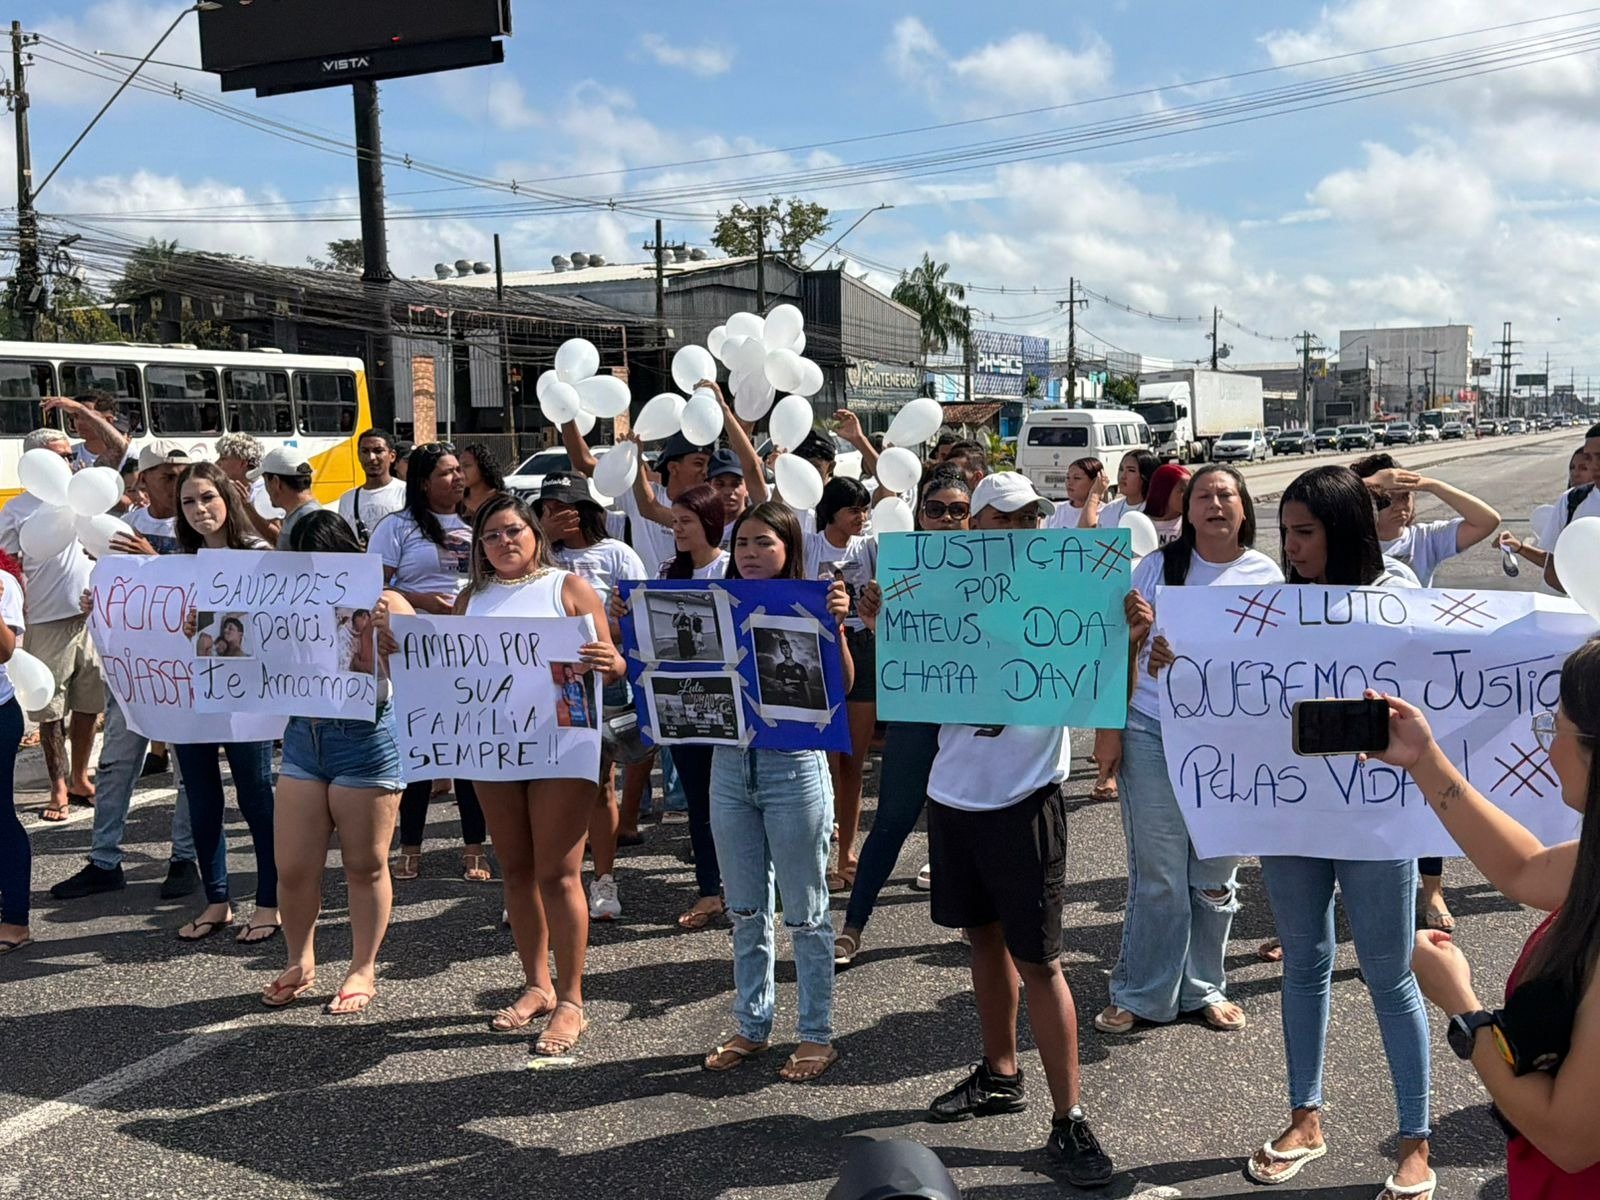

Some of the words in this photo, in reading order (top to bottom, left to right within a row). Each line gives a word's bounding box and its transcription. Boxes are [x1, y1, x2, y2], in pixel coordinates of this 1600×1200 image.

[322, 56, 369, 72] VISTA
[91, 576, 147, 631] NÃO
[209, 571, 349, 607] SAUDADES
[954, 572, 1021, 604] POR
[885, 608, 990, 649] MATEUS,
[1023, 606, 1117, 647] DOA
[403, 631, 490, 670] AMADO
[499, 631, 547, 668] POR
[199, 658, 247, 700] te
[454, 674, 514, 704] SUA
[880, 659, 978, 694] CHAPA
[1000, 658, 1101, 702] DAVI
[1180, 744, 1308, 809] PELAS
